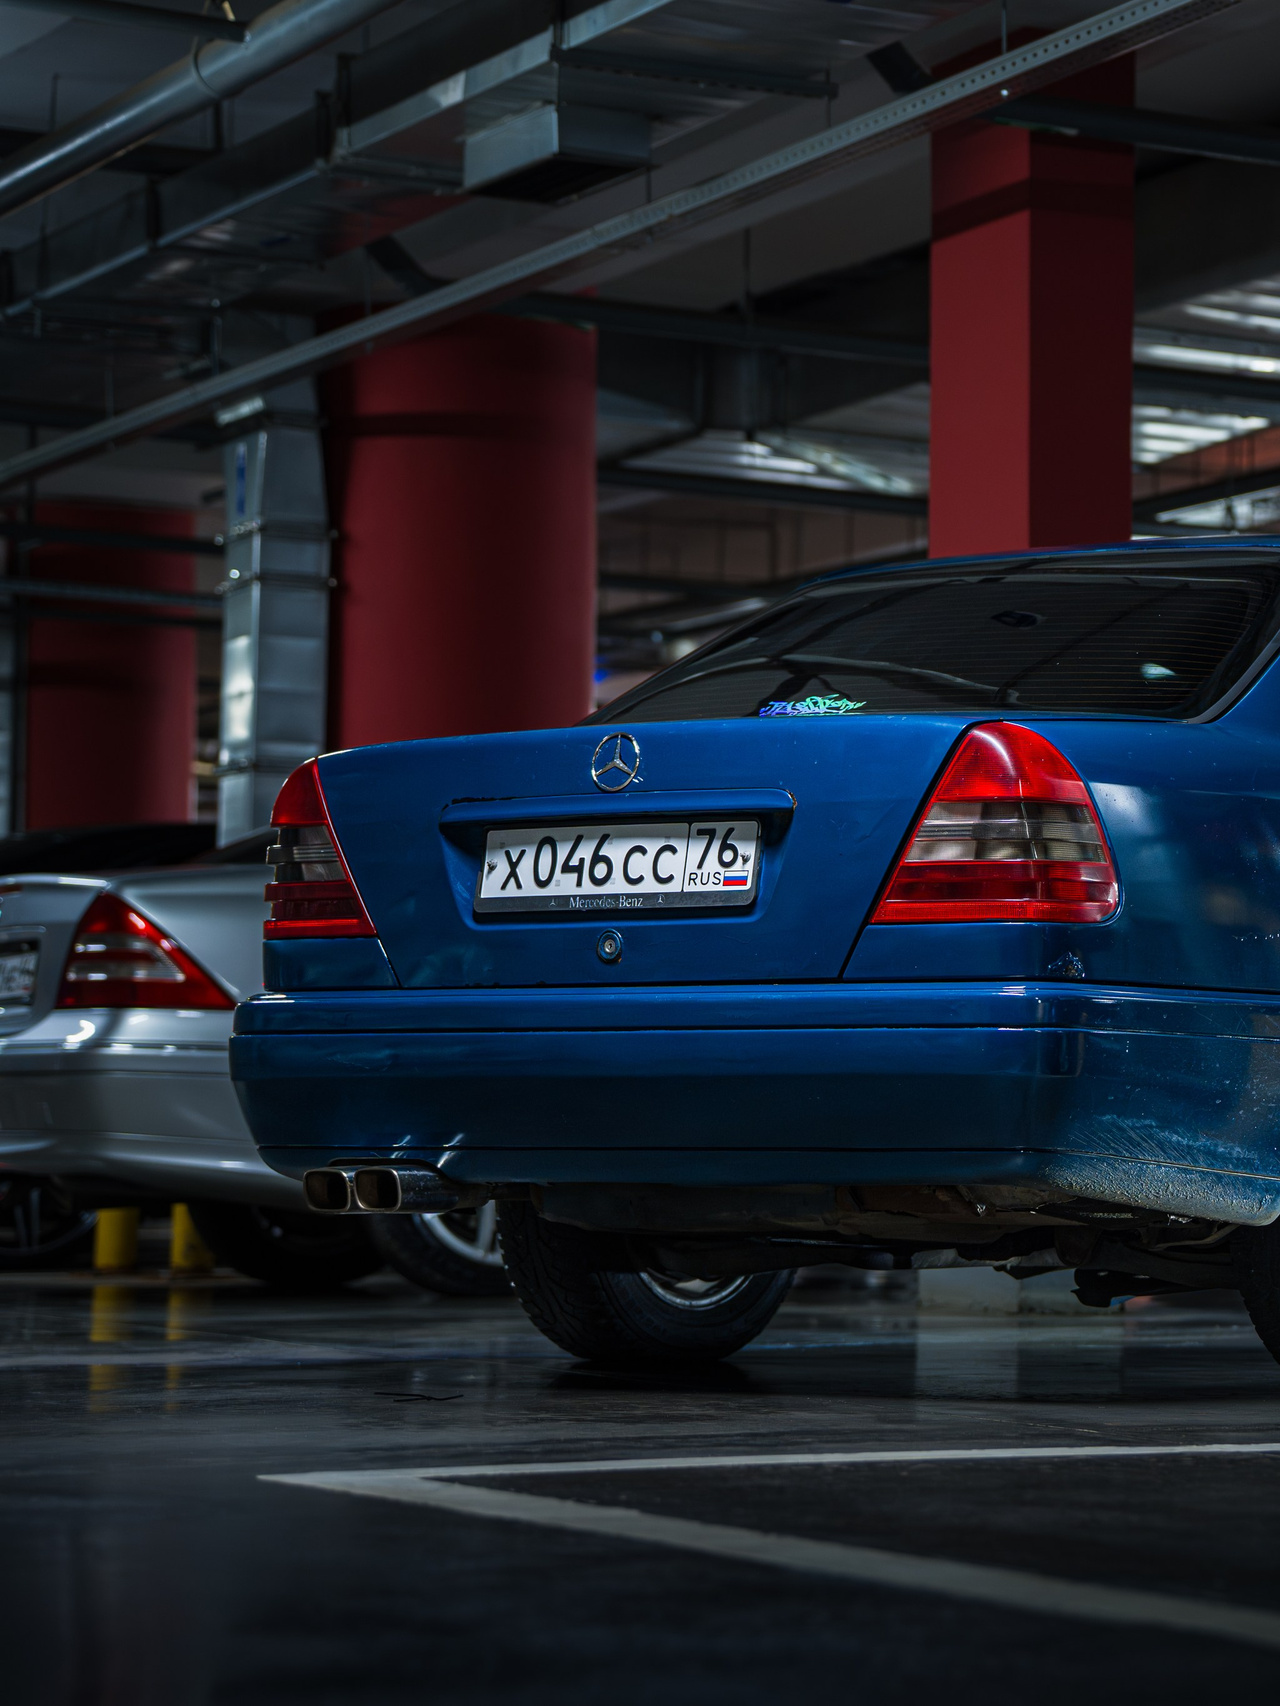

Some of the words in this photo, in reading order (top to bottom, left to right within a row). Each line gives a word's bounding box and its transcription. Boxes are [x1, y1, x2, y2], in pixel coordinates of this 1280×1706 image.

[696, 827, 739, 870] 76
[688, 871, 722, 887] RUS
[569, 895, 643, 909] Mercedes-Benz
